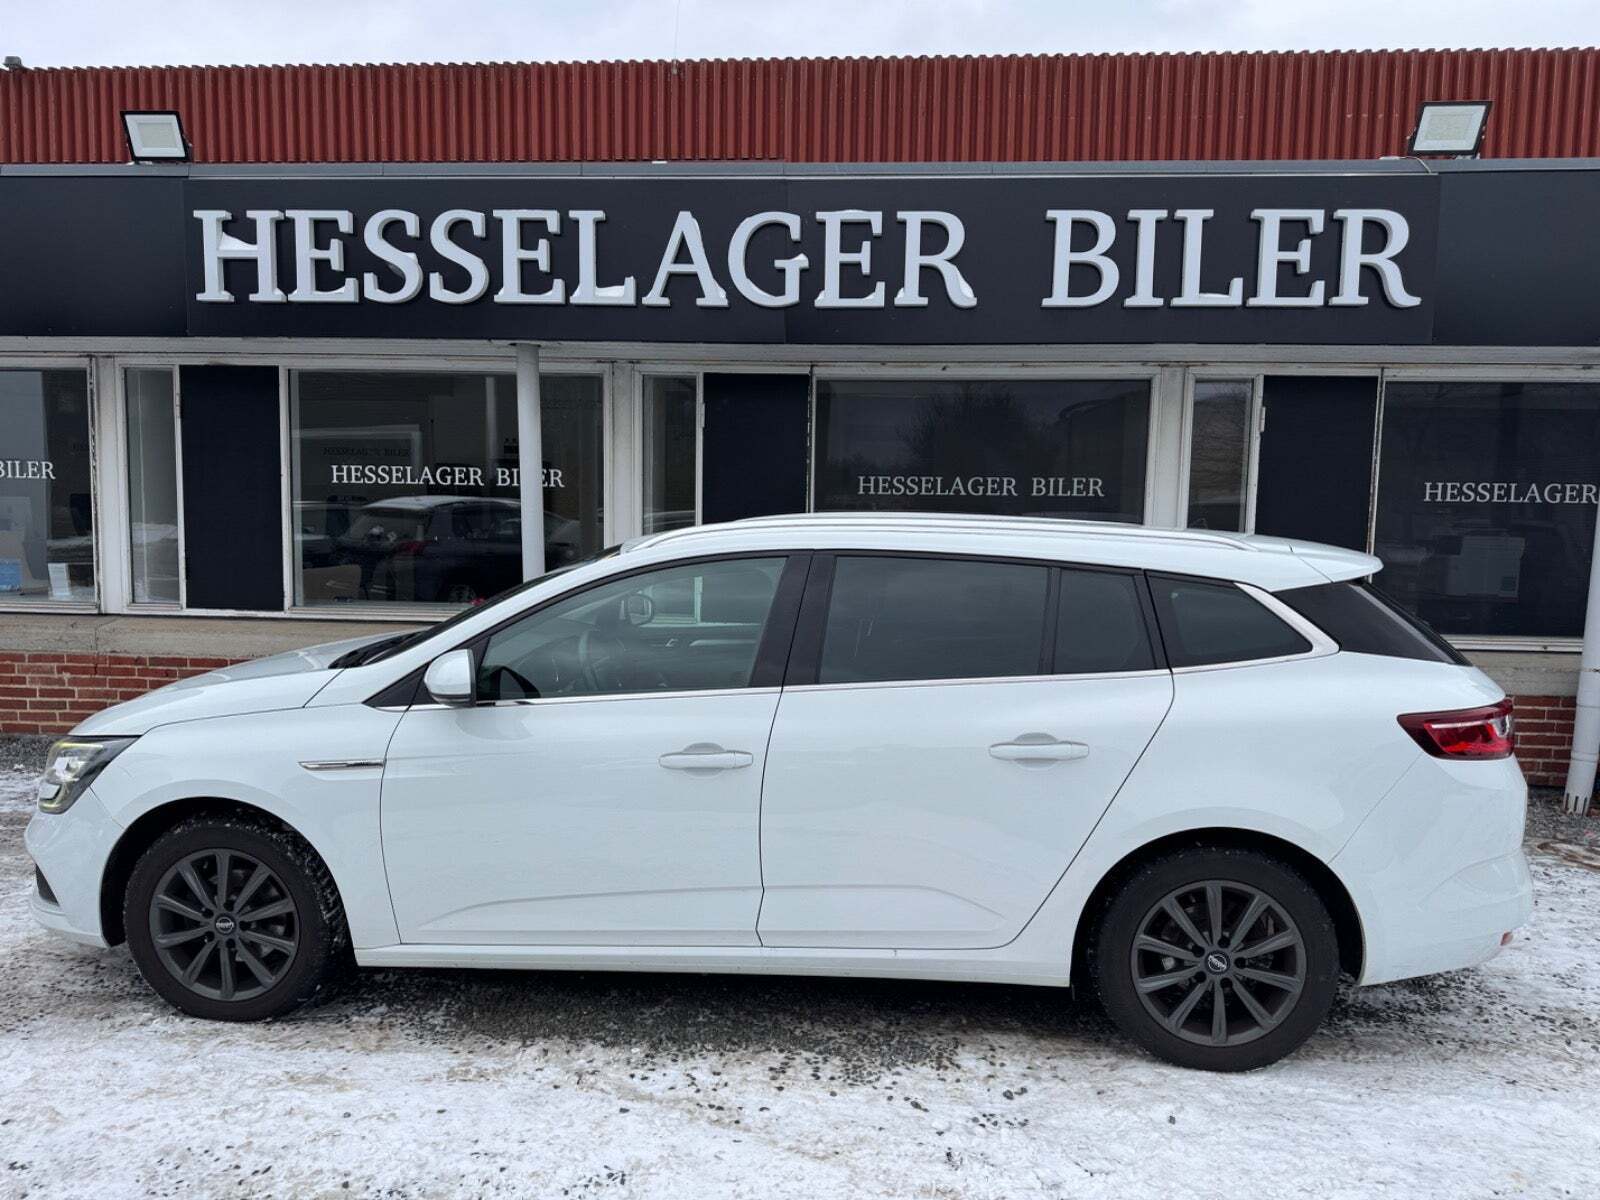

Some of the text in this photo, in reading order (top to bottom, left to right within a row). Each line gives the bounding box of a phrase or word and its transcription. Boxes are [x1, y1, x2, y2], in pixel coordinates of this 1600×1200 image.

[193, 208, 1422, 309] HESSELAGER BILER
[331, 464, 566, 488] HESSELAGER BIR
[857, 475, 1105, 498] HESSELAGER BILER
[1423, 481, 1598, 505] HESSELAGER
